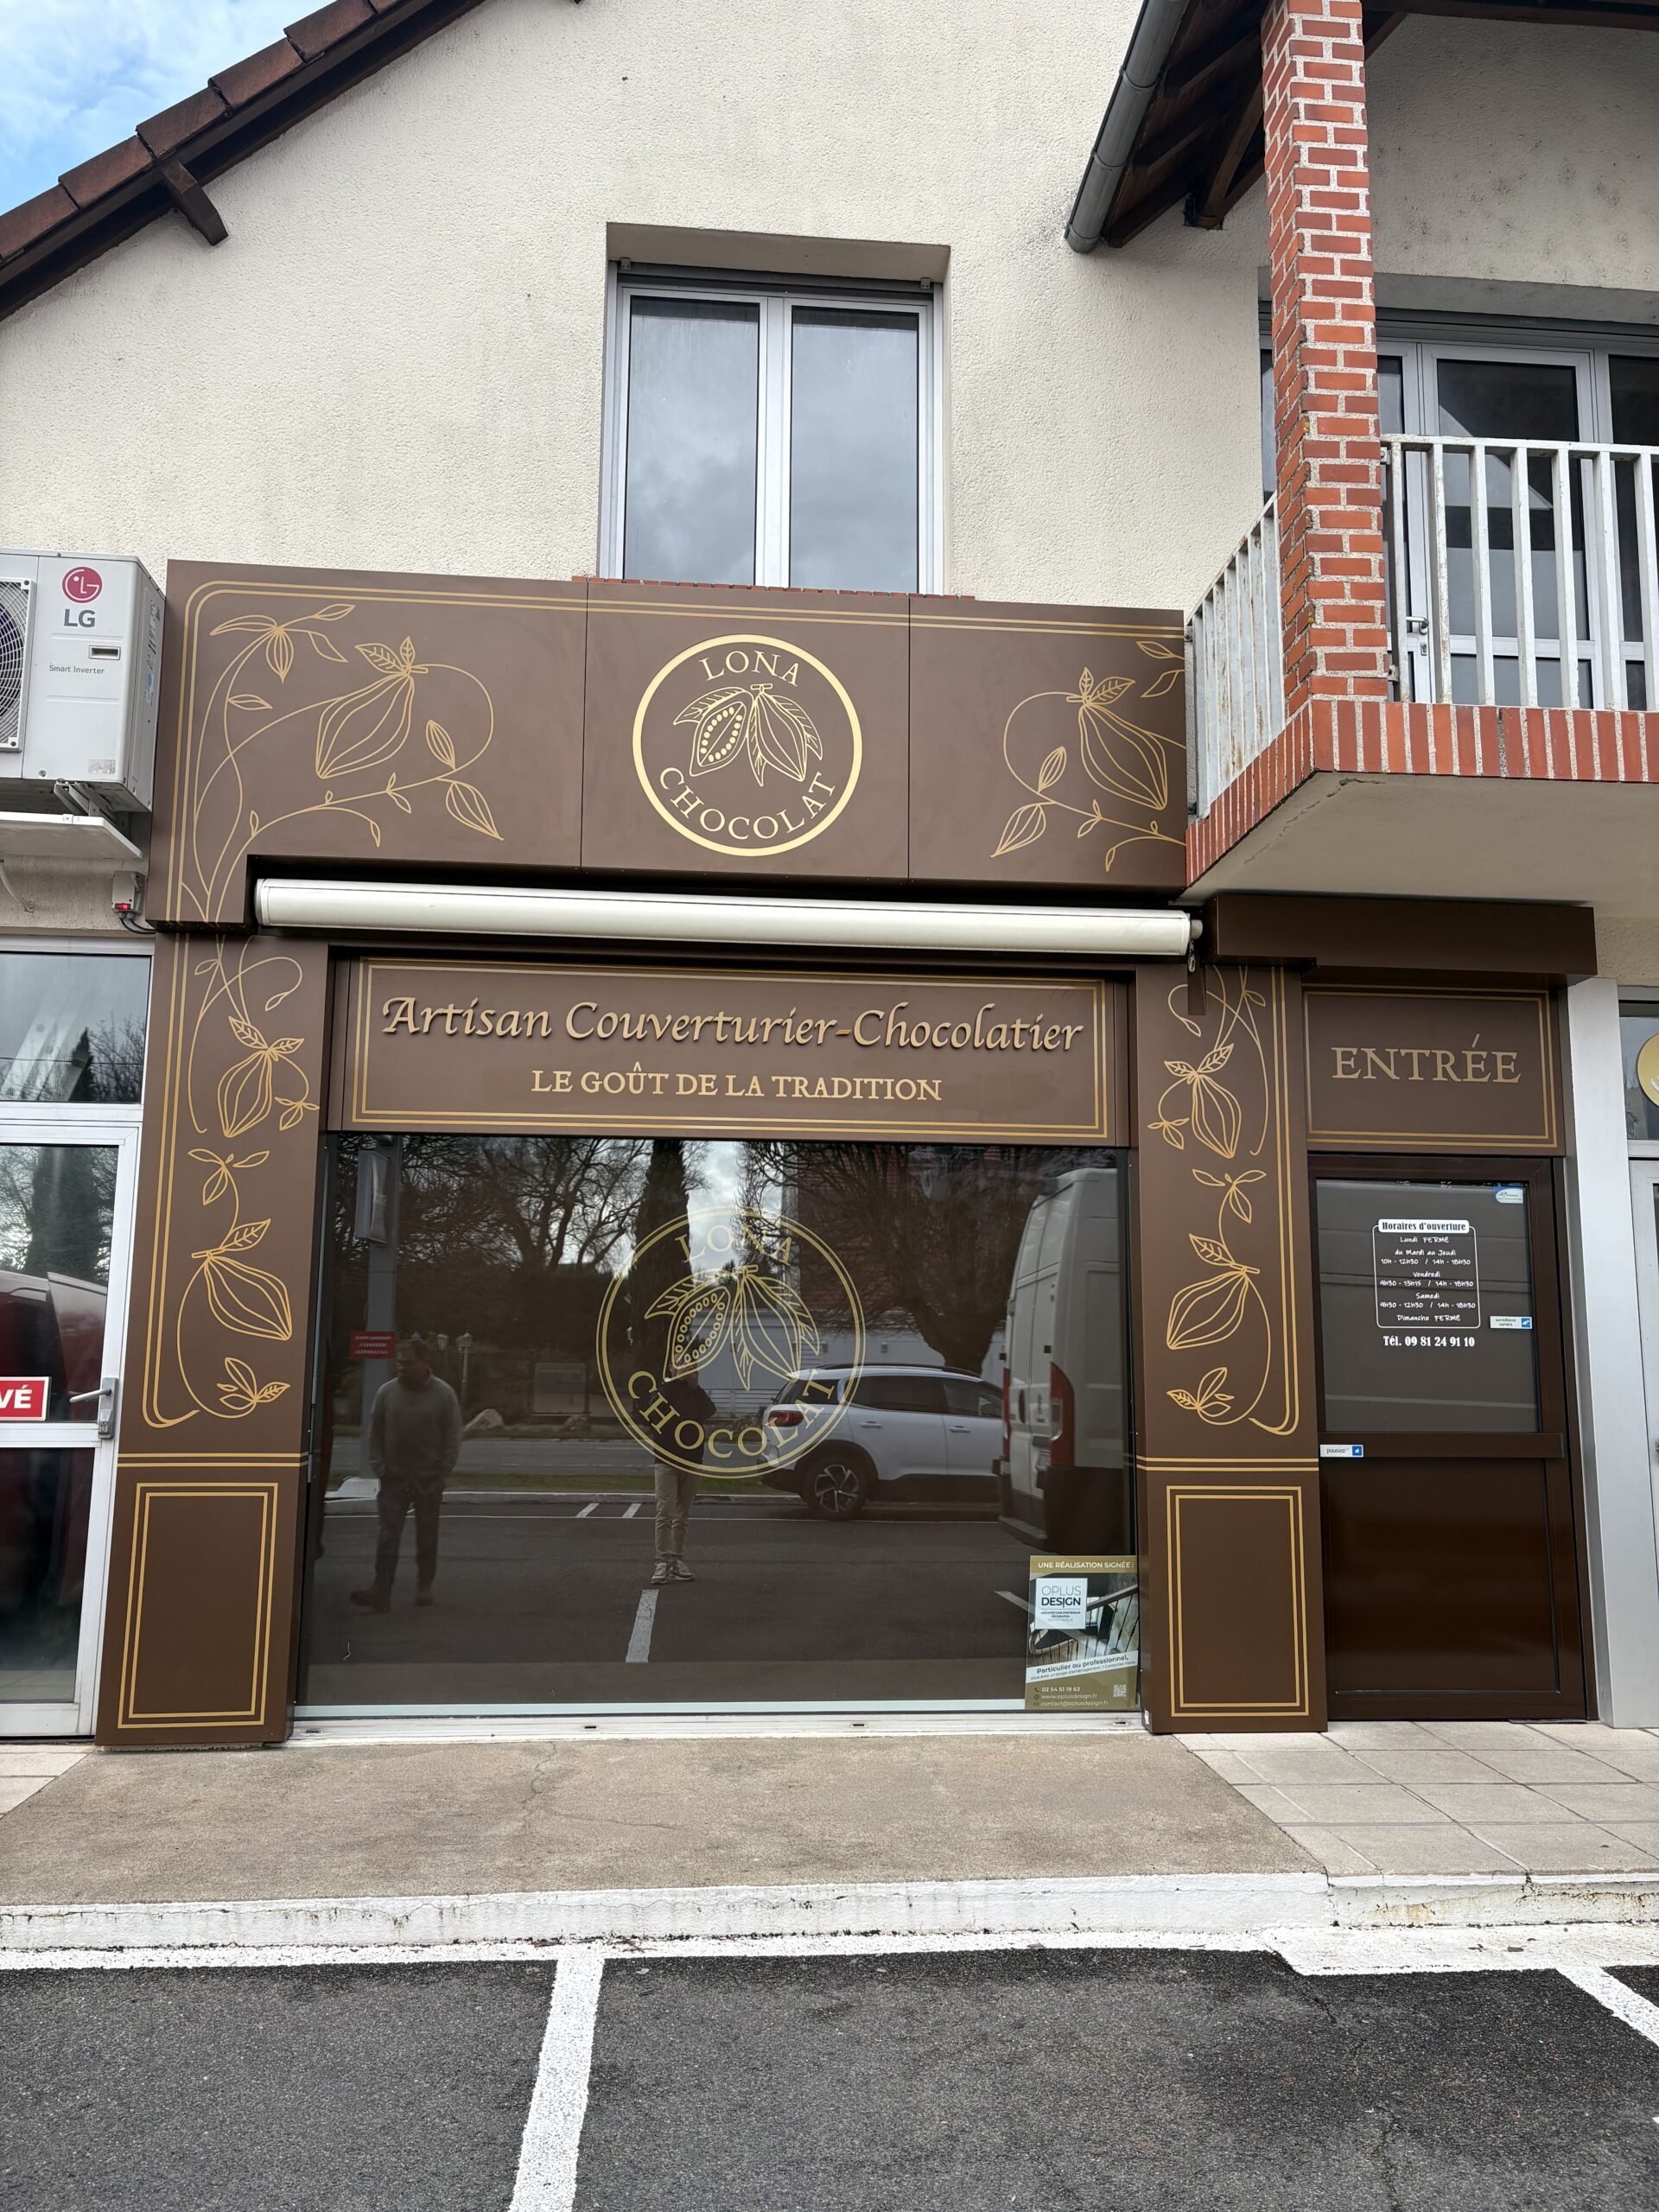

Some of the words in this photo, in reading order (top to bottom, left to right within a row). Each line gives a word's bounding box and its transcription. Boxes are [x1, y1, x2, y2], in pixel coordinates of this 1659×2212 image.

[64, 609, 96, 628] LG
[48, 664, 72, 673] Smart
[73, 665, 105, 675] Inverter
[698, 650, 799, 687] LONA
[659, 766, 836, 840] CHOCOLAT
[381, 996, 552, 1037] Artisan
[565, 1001, 1084, 1051] Couverturier-Chocolatier
[1332, 1033, 1522, 1084] ENTRÉE
[531, 1070, 573, 1093] LE
[581, 1061, 670, 1095] GOÛT
[676, 1073, 719, 1096] DE
[726, 1074, 765, 1097] LA
[772, 1076, 943, 1102] TRADITION
[1382, 1222, 1417, 1230] Horaires
[1419, 1222, 1466, 1231] d'ouverture
[1382, 1335, 1402, 1346] Tél.
[1404, 1336, 1418, 1346] 09
[1420, 1336, 1432, 1347] 81
[1433, 1336, 1447, 1347] 24
[1449, 1336, 1461, 1347] 91
[1463, 1337, 1475, 1347] 10
[628, 1370, 836, 1459] CHOCOLAT
[1041, 1586, 1082, 1596] OPLUS
[1041, 1597, 1081, 1608] DESIGN
[1036, 1664, 1071, 1674] Particulier
[1082, 1654, 1129, 1669] professionnel,
